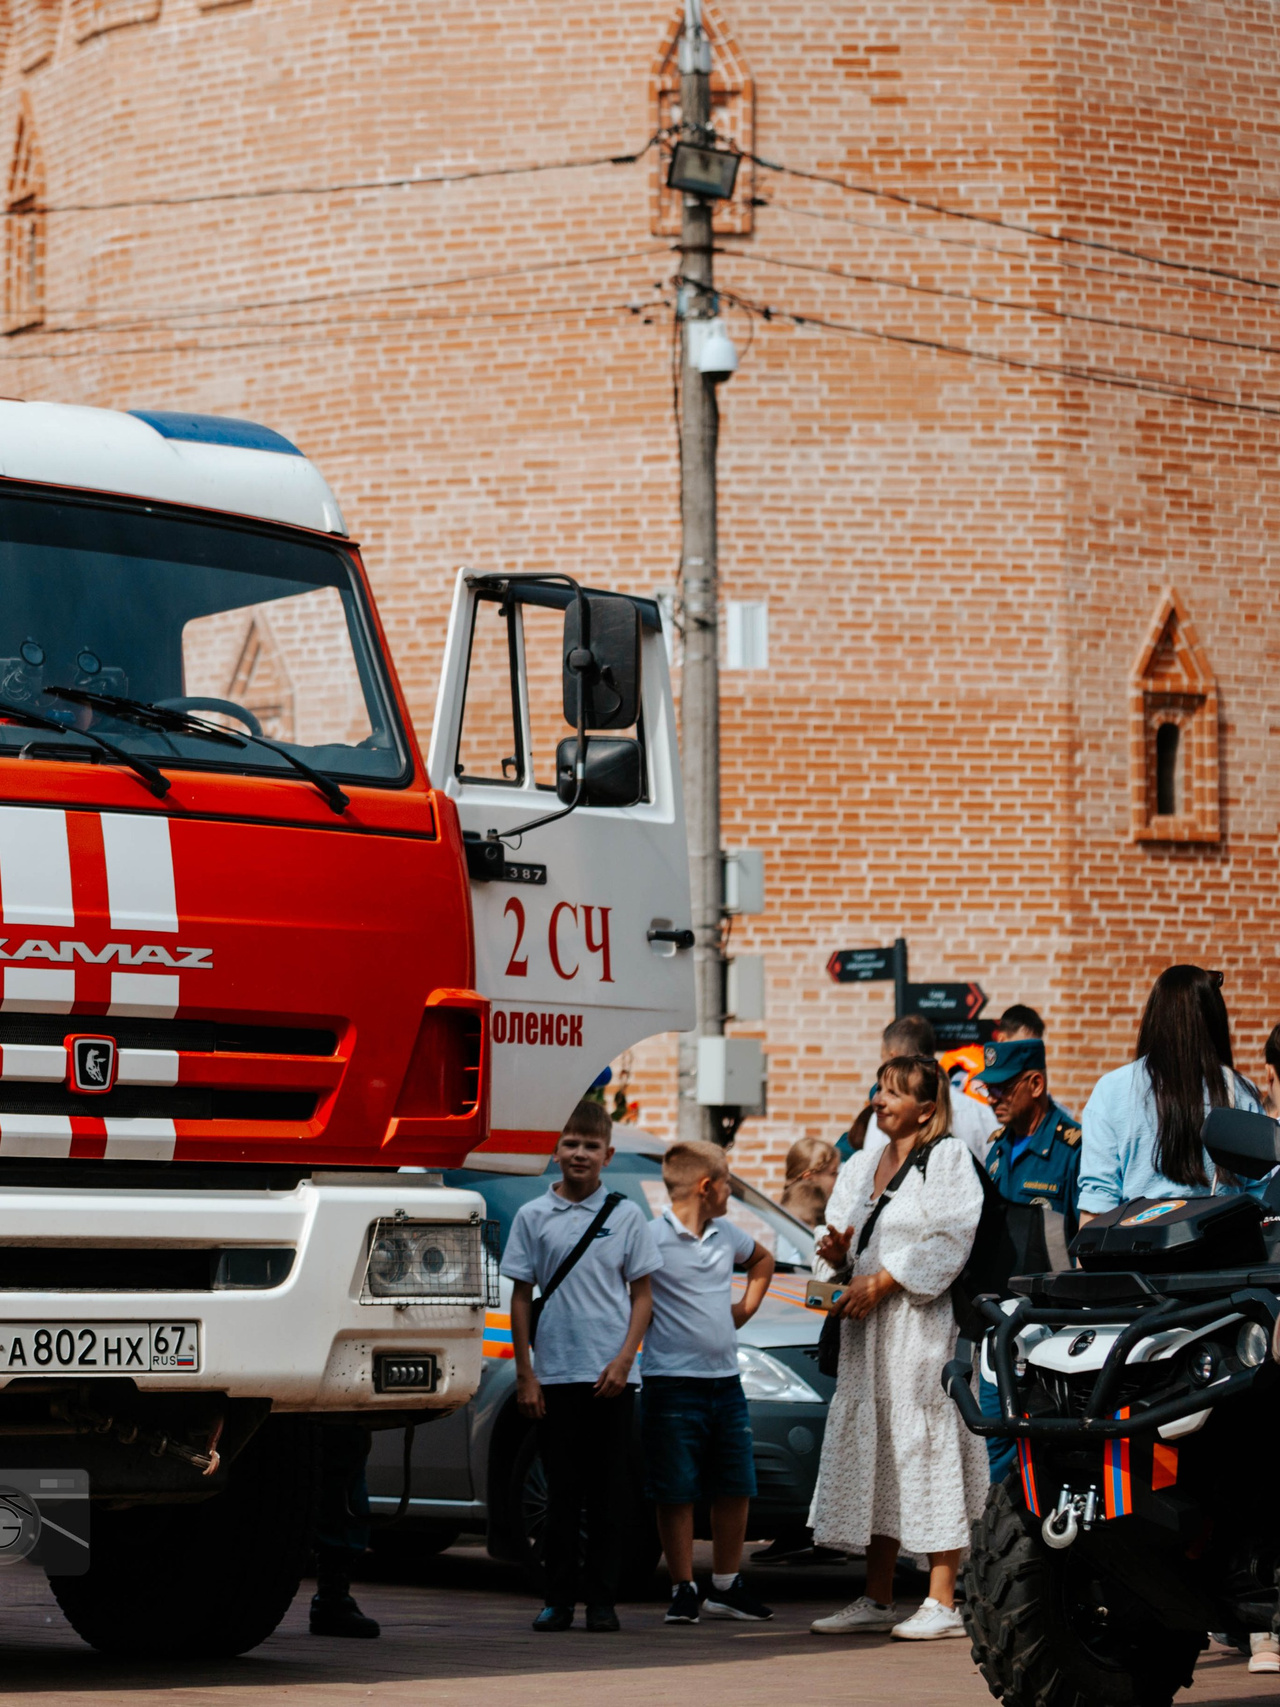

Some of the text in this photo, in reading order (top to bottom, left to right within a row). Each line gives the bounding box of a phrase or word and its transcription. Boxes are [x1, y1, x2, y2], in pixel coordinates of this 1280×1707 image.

[510, 867, 543, 881] 387
[503, 896, 616, 984] 2 СЧ
[492, 1010, 584, 1047] оленск
[154, 1326, 186, 1355] 67
[152, 1355, 176, 1366] RUS
